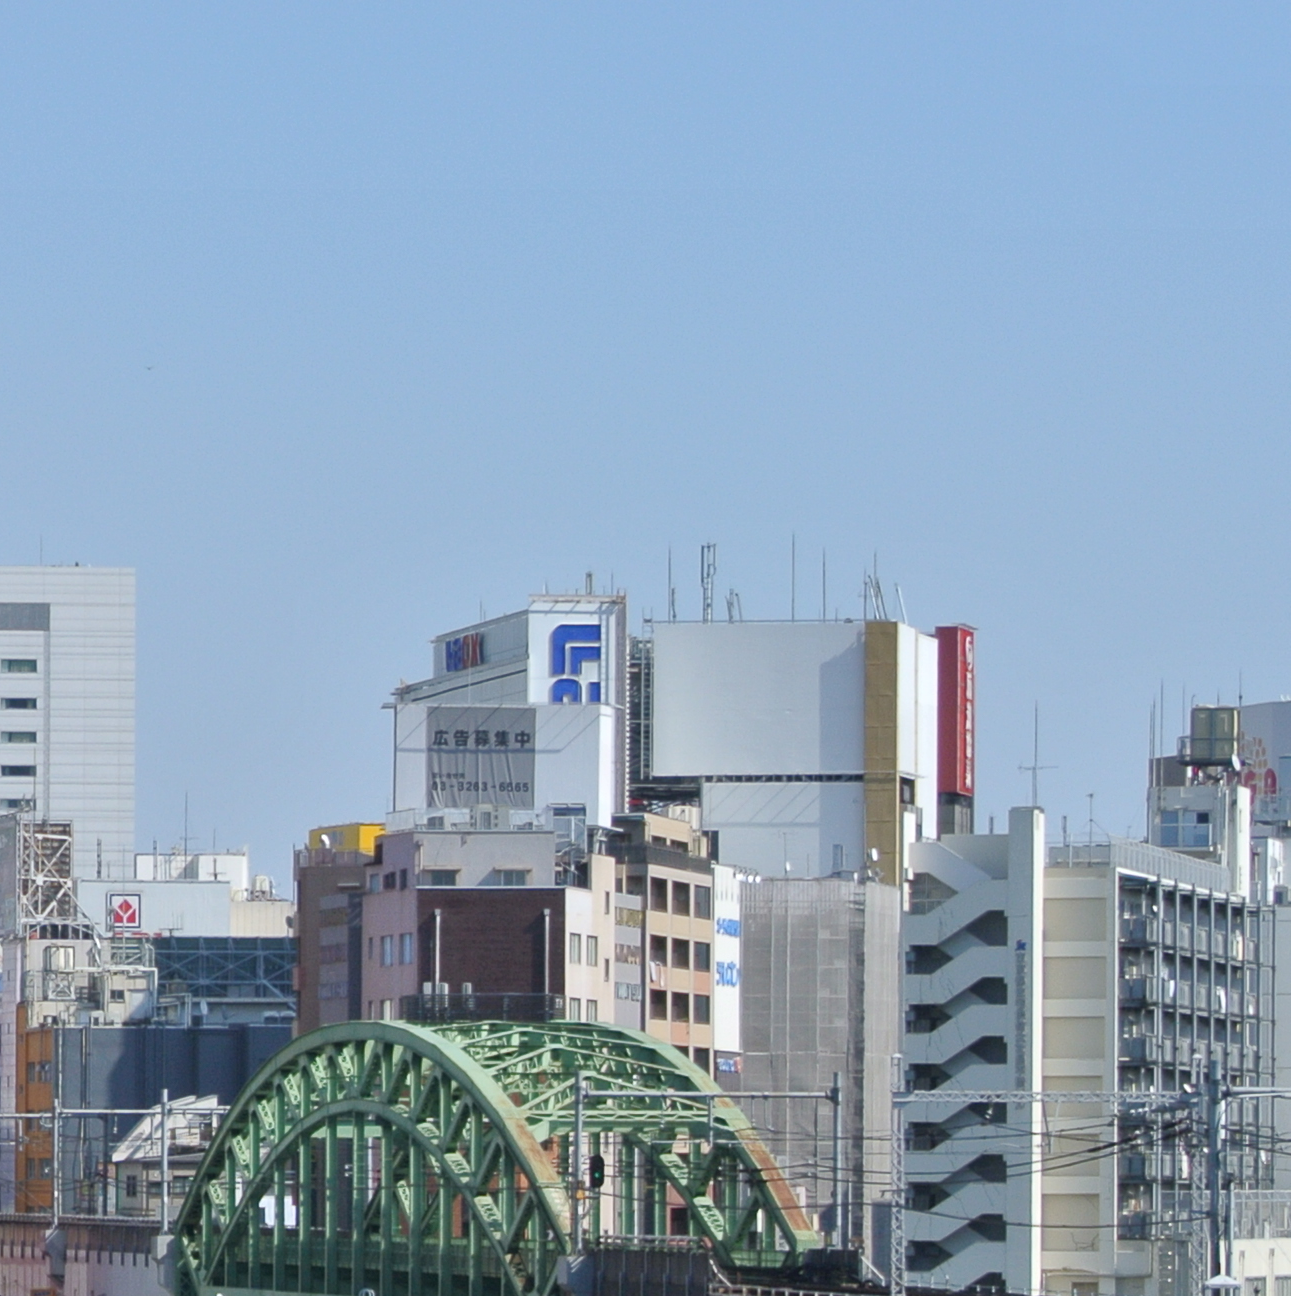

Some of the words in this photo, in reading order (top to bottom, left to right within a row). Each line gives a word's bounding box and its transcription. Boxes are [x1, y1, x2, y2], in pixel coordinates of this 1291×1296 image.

[432, 729, 531, 748] 広告募集中
